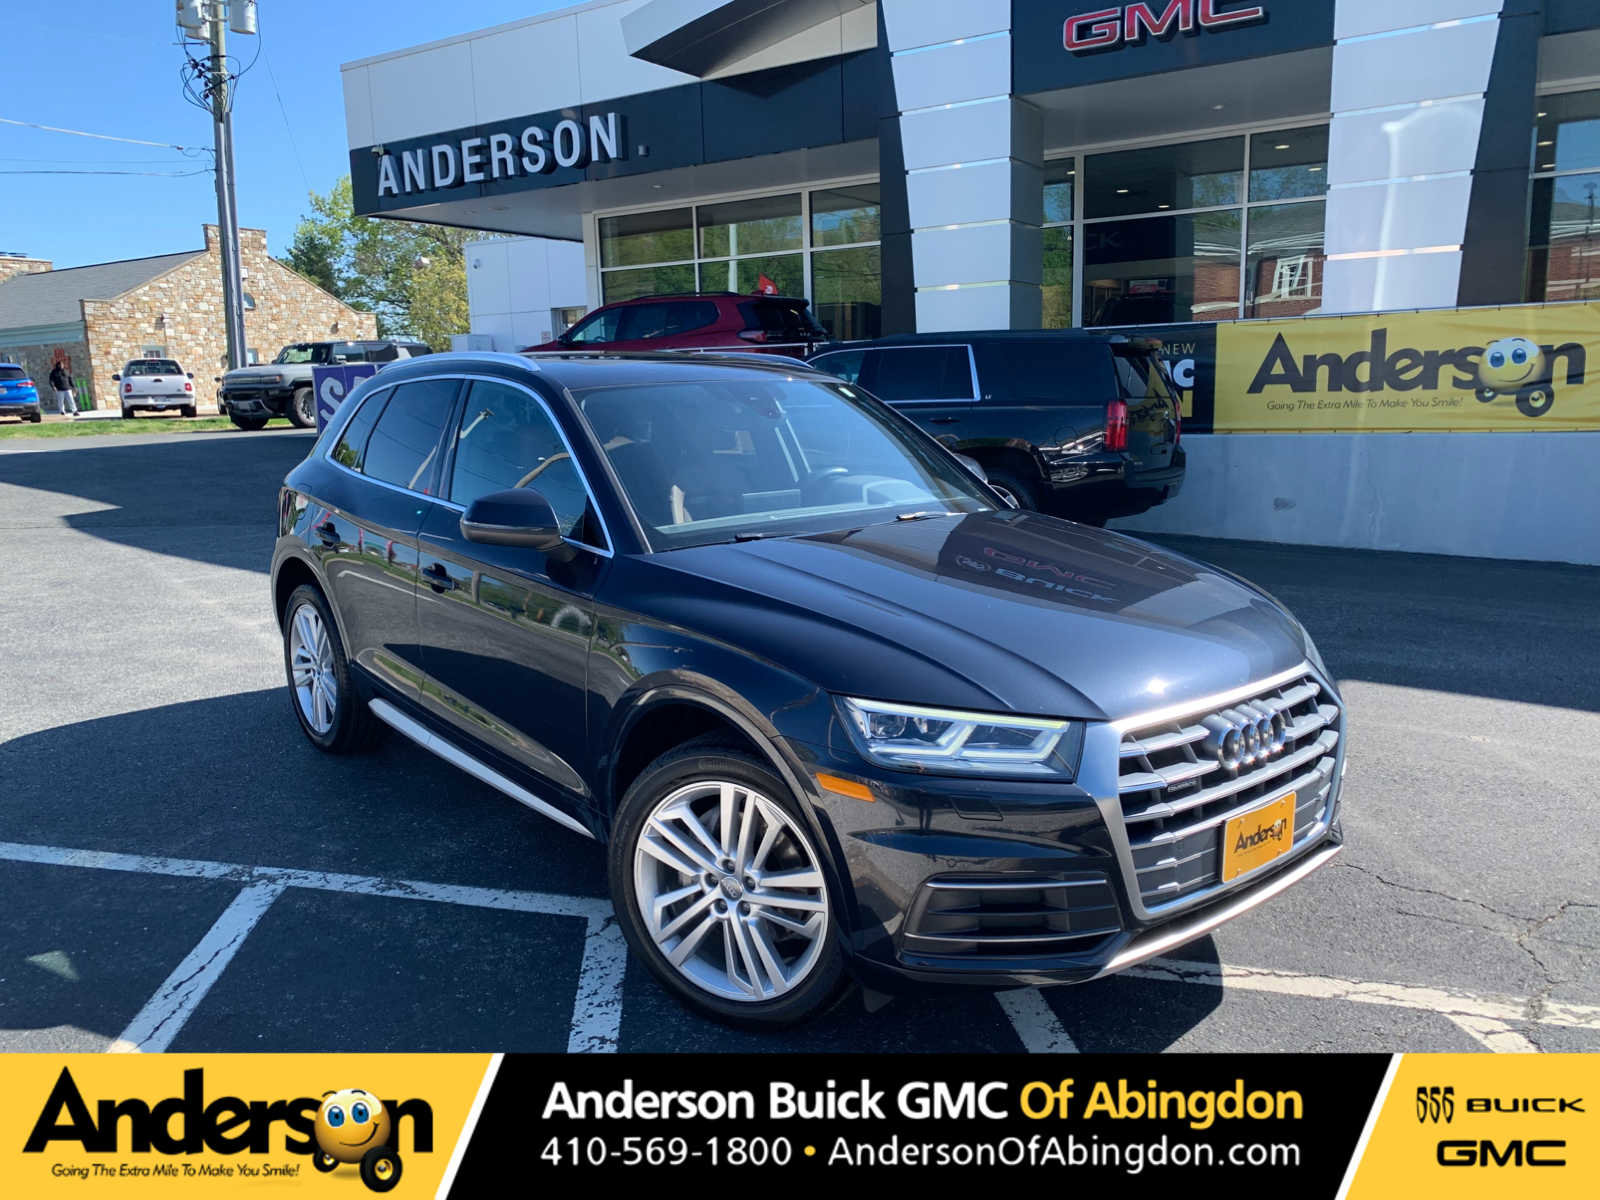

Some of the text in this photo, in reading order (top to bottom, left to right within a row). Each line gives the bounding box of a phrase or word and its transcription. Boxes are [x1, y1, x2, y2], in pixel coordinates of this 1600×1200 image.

[1063, 0, 1264, 51] GMC
[377, 111, 618, 197] ANDERSON
[1266, 400, 1295, 411] Going
[1297, 400, 1315, 409] The
[1316, 399, 1341, 409] Extra
[1367, 399, 1378, 408] To
[1378, 398, 1407, 408] Make
[1410, 397, 1430, 407] You
[1431, 396, 1464, 407] Smile!
